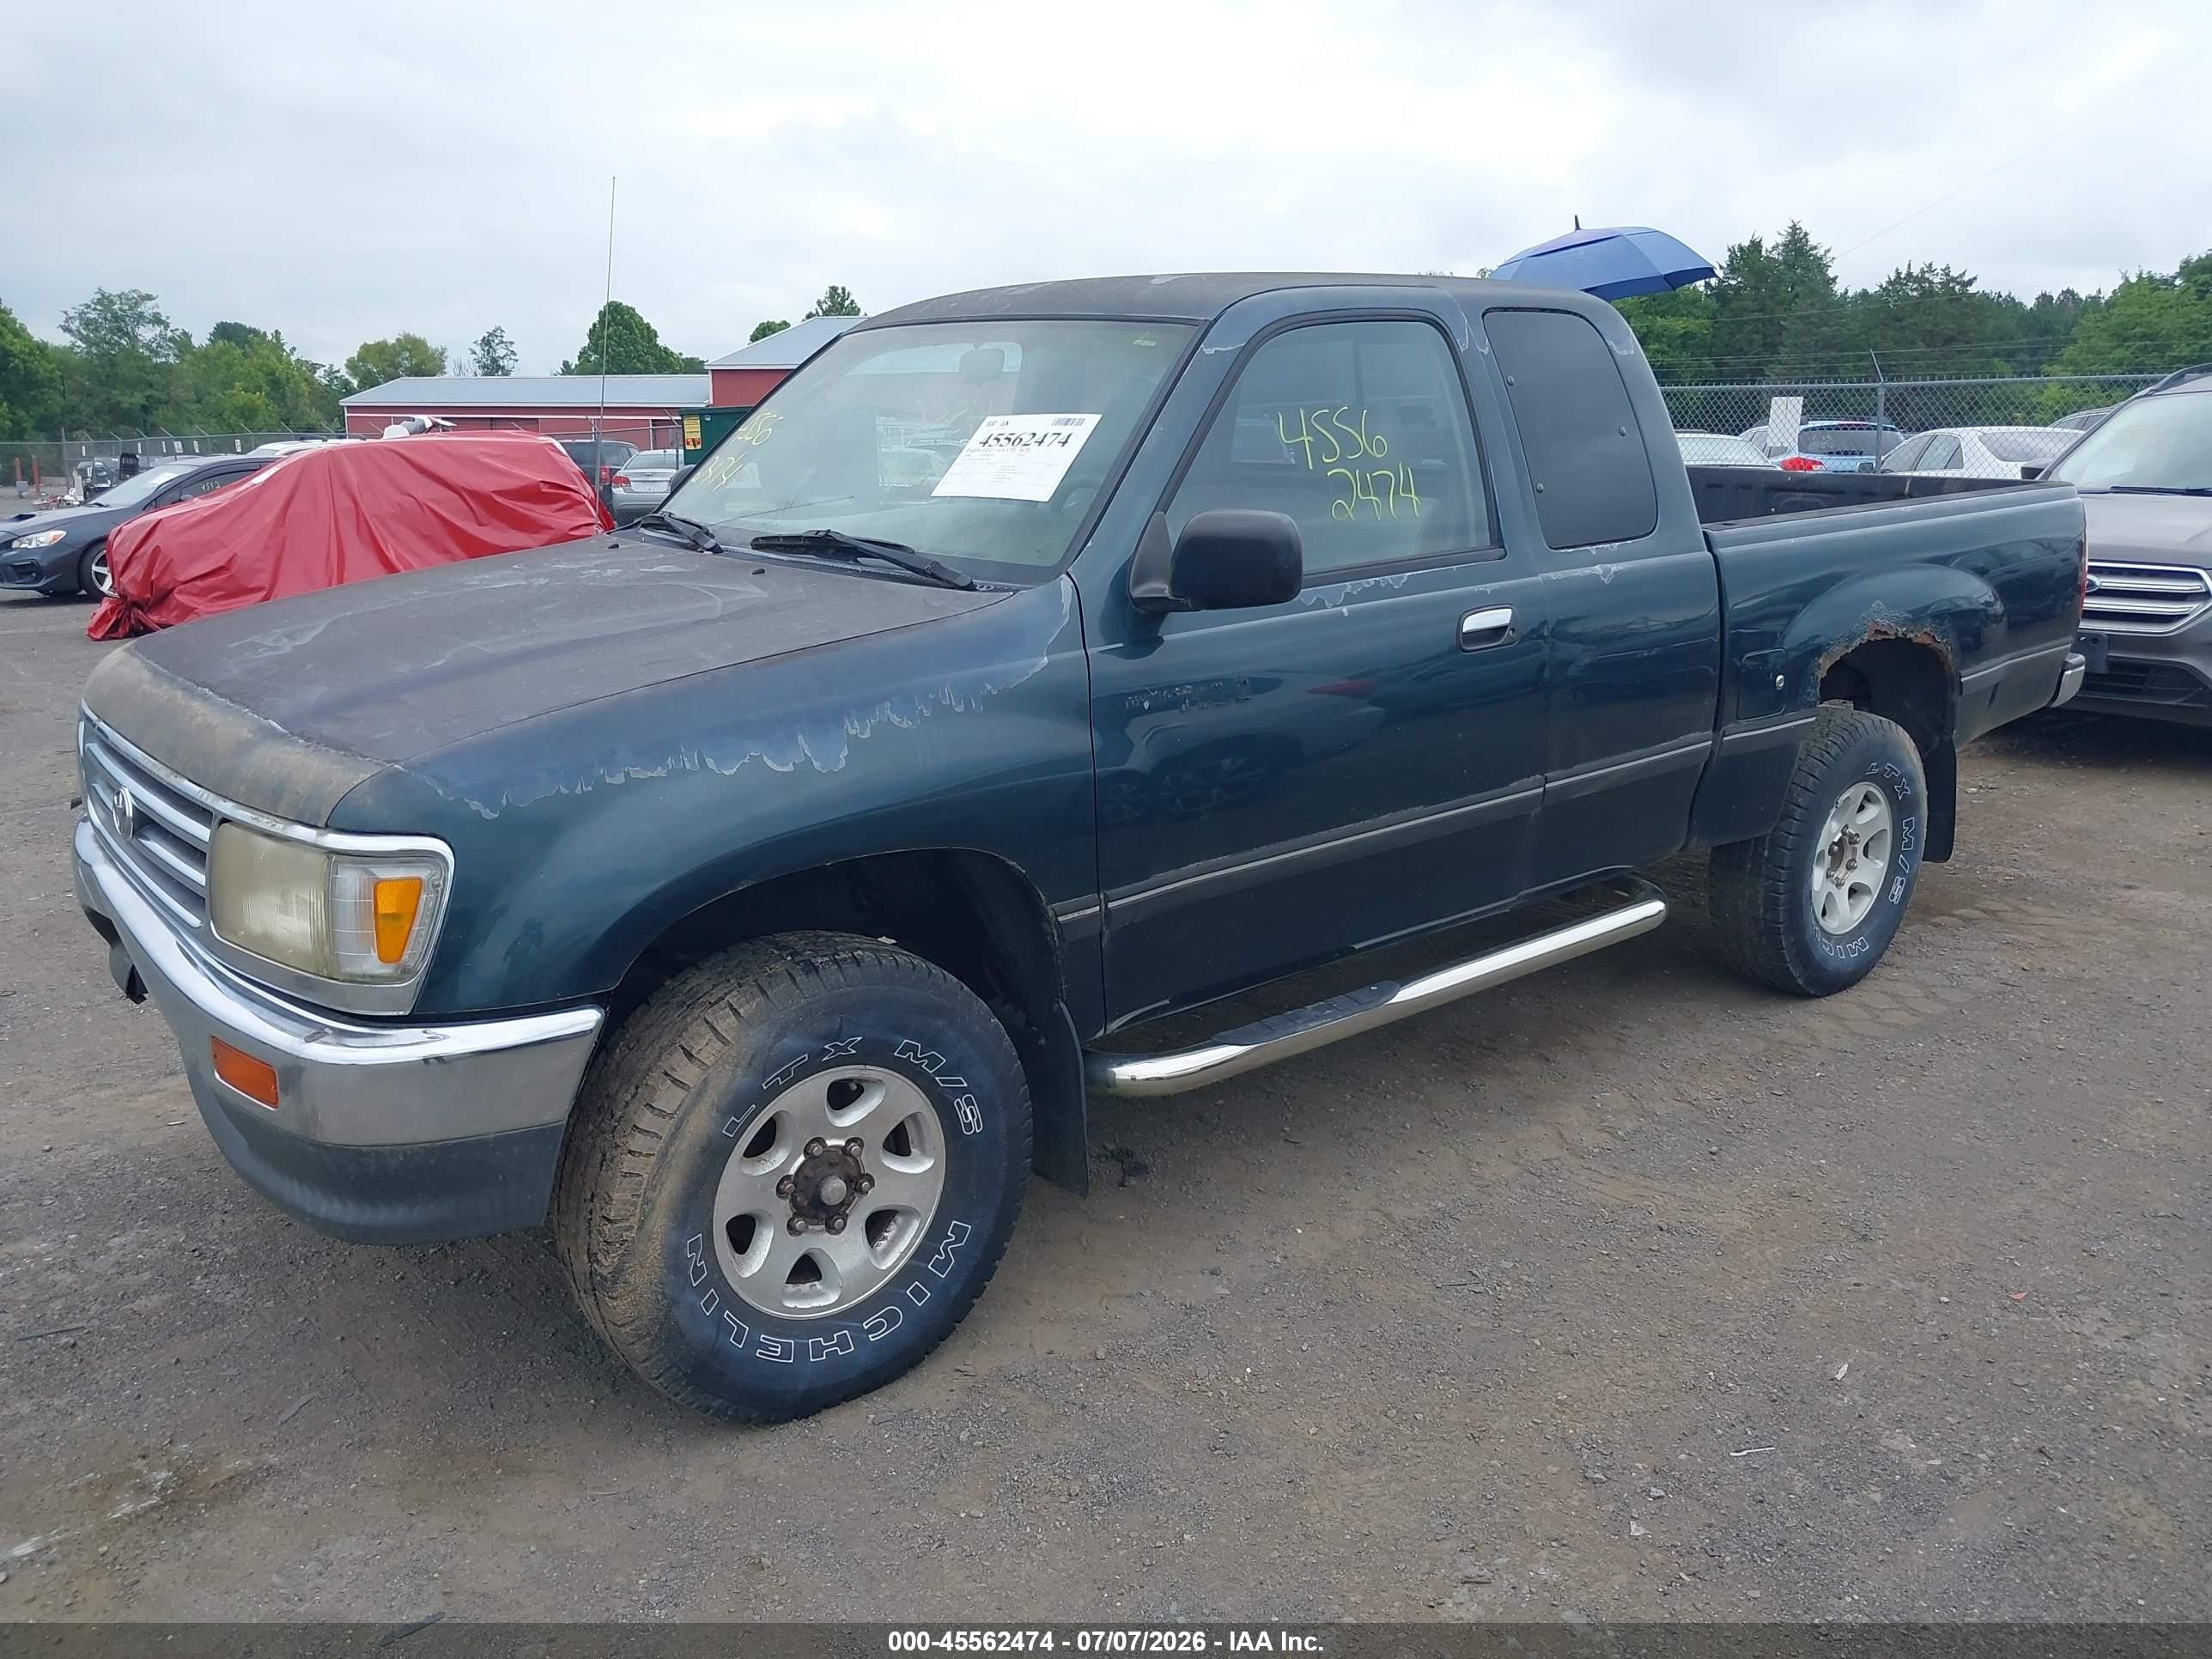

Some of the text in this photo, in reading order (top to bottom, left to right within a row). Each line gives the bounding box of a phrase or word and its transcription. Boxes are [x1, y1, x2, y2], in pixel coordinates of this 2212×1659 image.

[979, 432, 1074, 447] 45562474
[1278, 407, 1388, 470] 4556
[1328, 461, 1420, 521] 2474
[1865, 763, 1911, 800] LTX
[722, 1036, 863, 1138] LTX
[687, 1220, 972, 1363] MICHELIN
